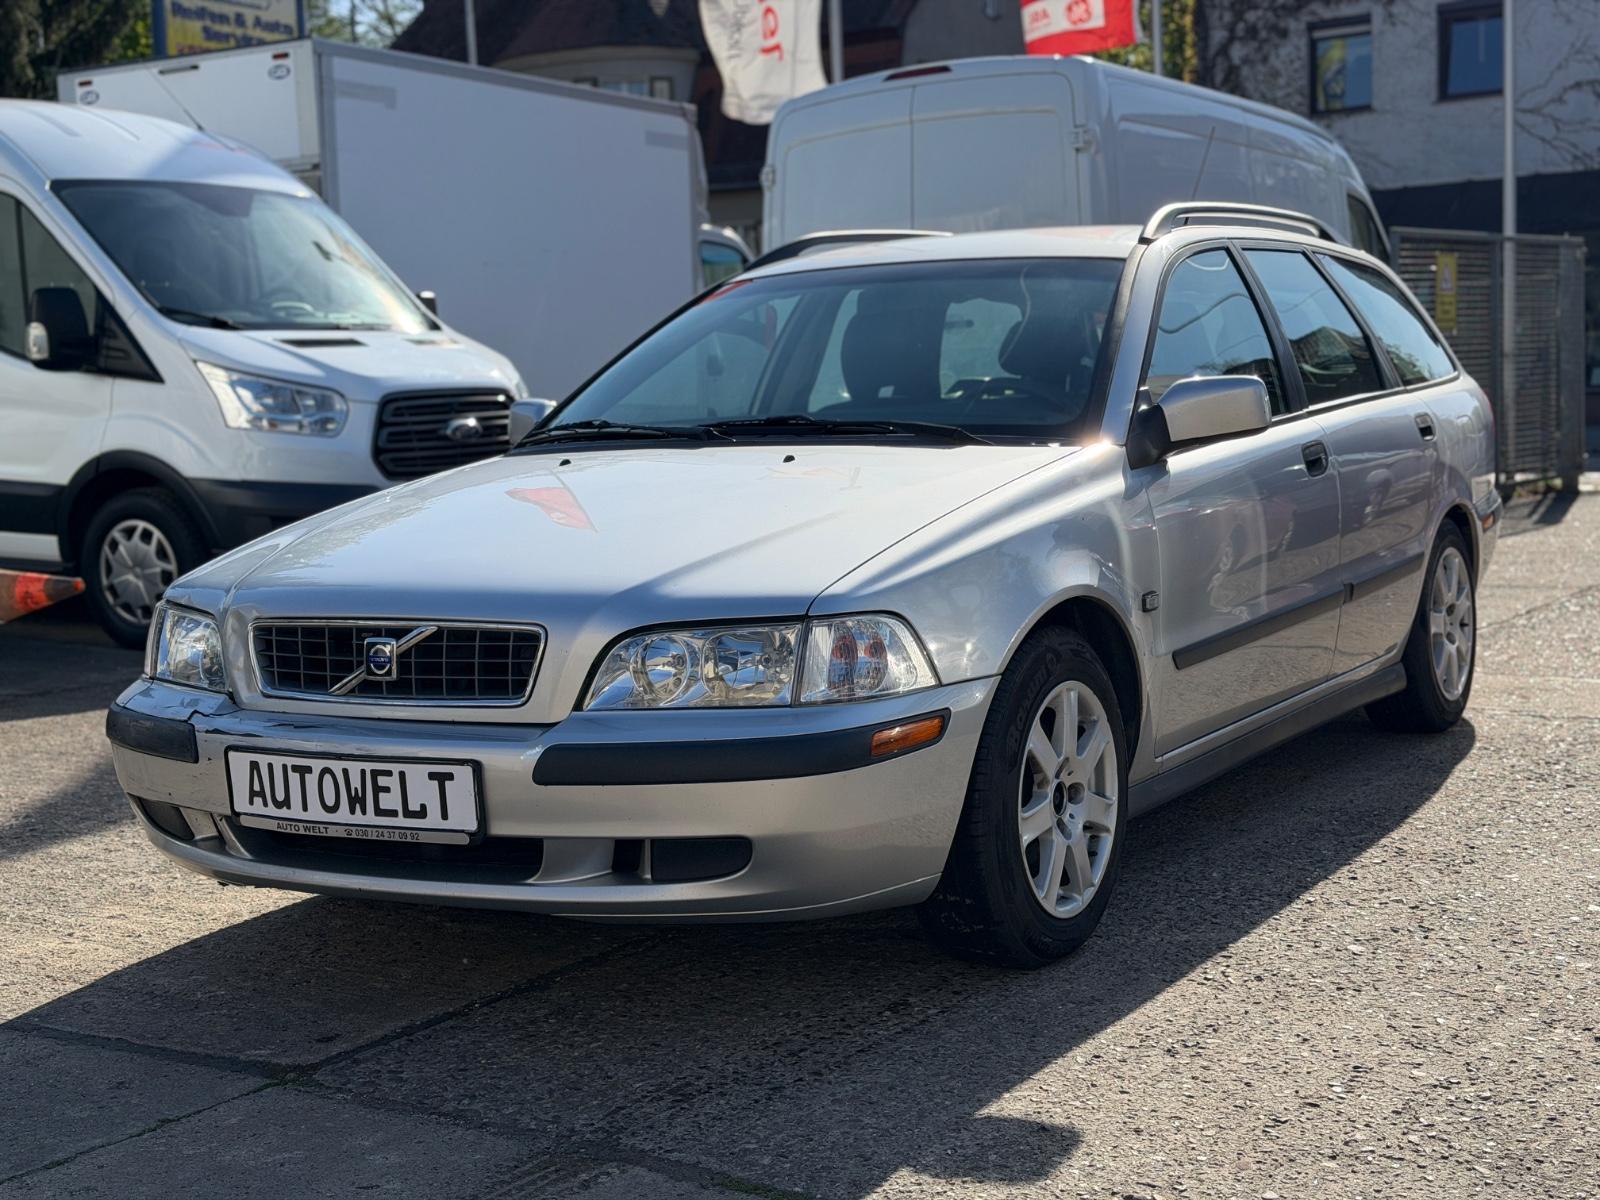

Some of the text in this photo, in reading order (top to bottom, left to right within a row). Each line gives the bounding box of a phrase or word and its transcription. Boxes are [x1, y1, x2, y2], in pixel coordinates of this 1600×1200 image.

[171, 1, 293, 35] Reifen & Auto
[248, 760, 455, 821] AUTOWELT
[276, 822, 300, 833] AUTO
[302, 825, 329, 836] WELT
[355, 829, 369, 838] 030
[376, 830, 385, 839] 24
[387, 831, 396, 840] 37
[398, 832, 408, 841] 09
[409, 832, 420, 842] 92
